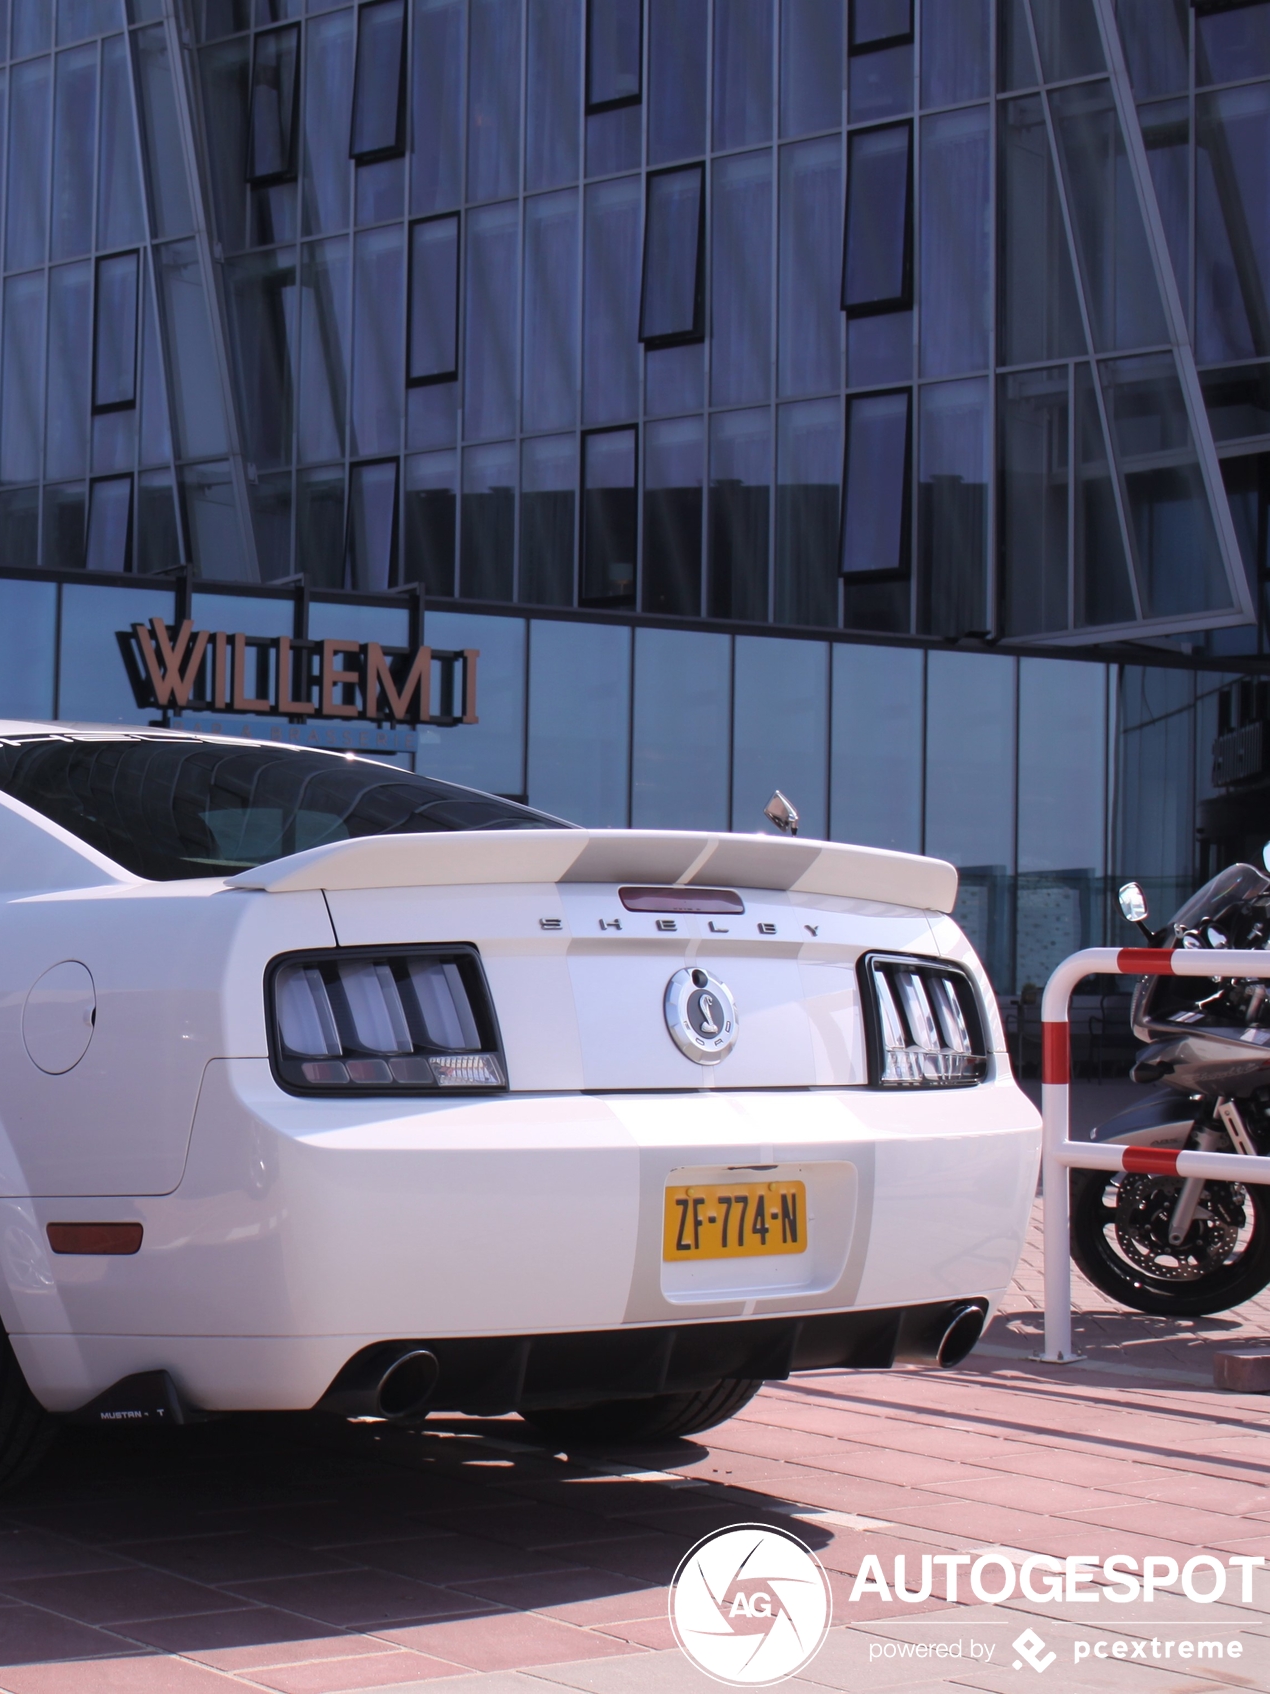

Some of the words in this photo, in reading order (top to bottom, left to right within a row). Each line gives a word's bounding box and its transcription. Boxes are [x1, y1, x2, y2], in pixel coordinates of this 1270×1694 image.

[136, 617, 431, 720] WILLEM
[461, 648, 480, 724] I
[270, 725, 416, 749] BRASSERIE
[539, 918, 821, 937] SHELBY
[675, 1192, 798, 1251] ZF-774-N
[100, 1410, 149, 1420] MUSTAN
